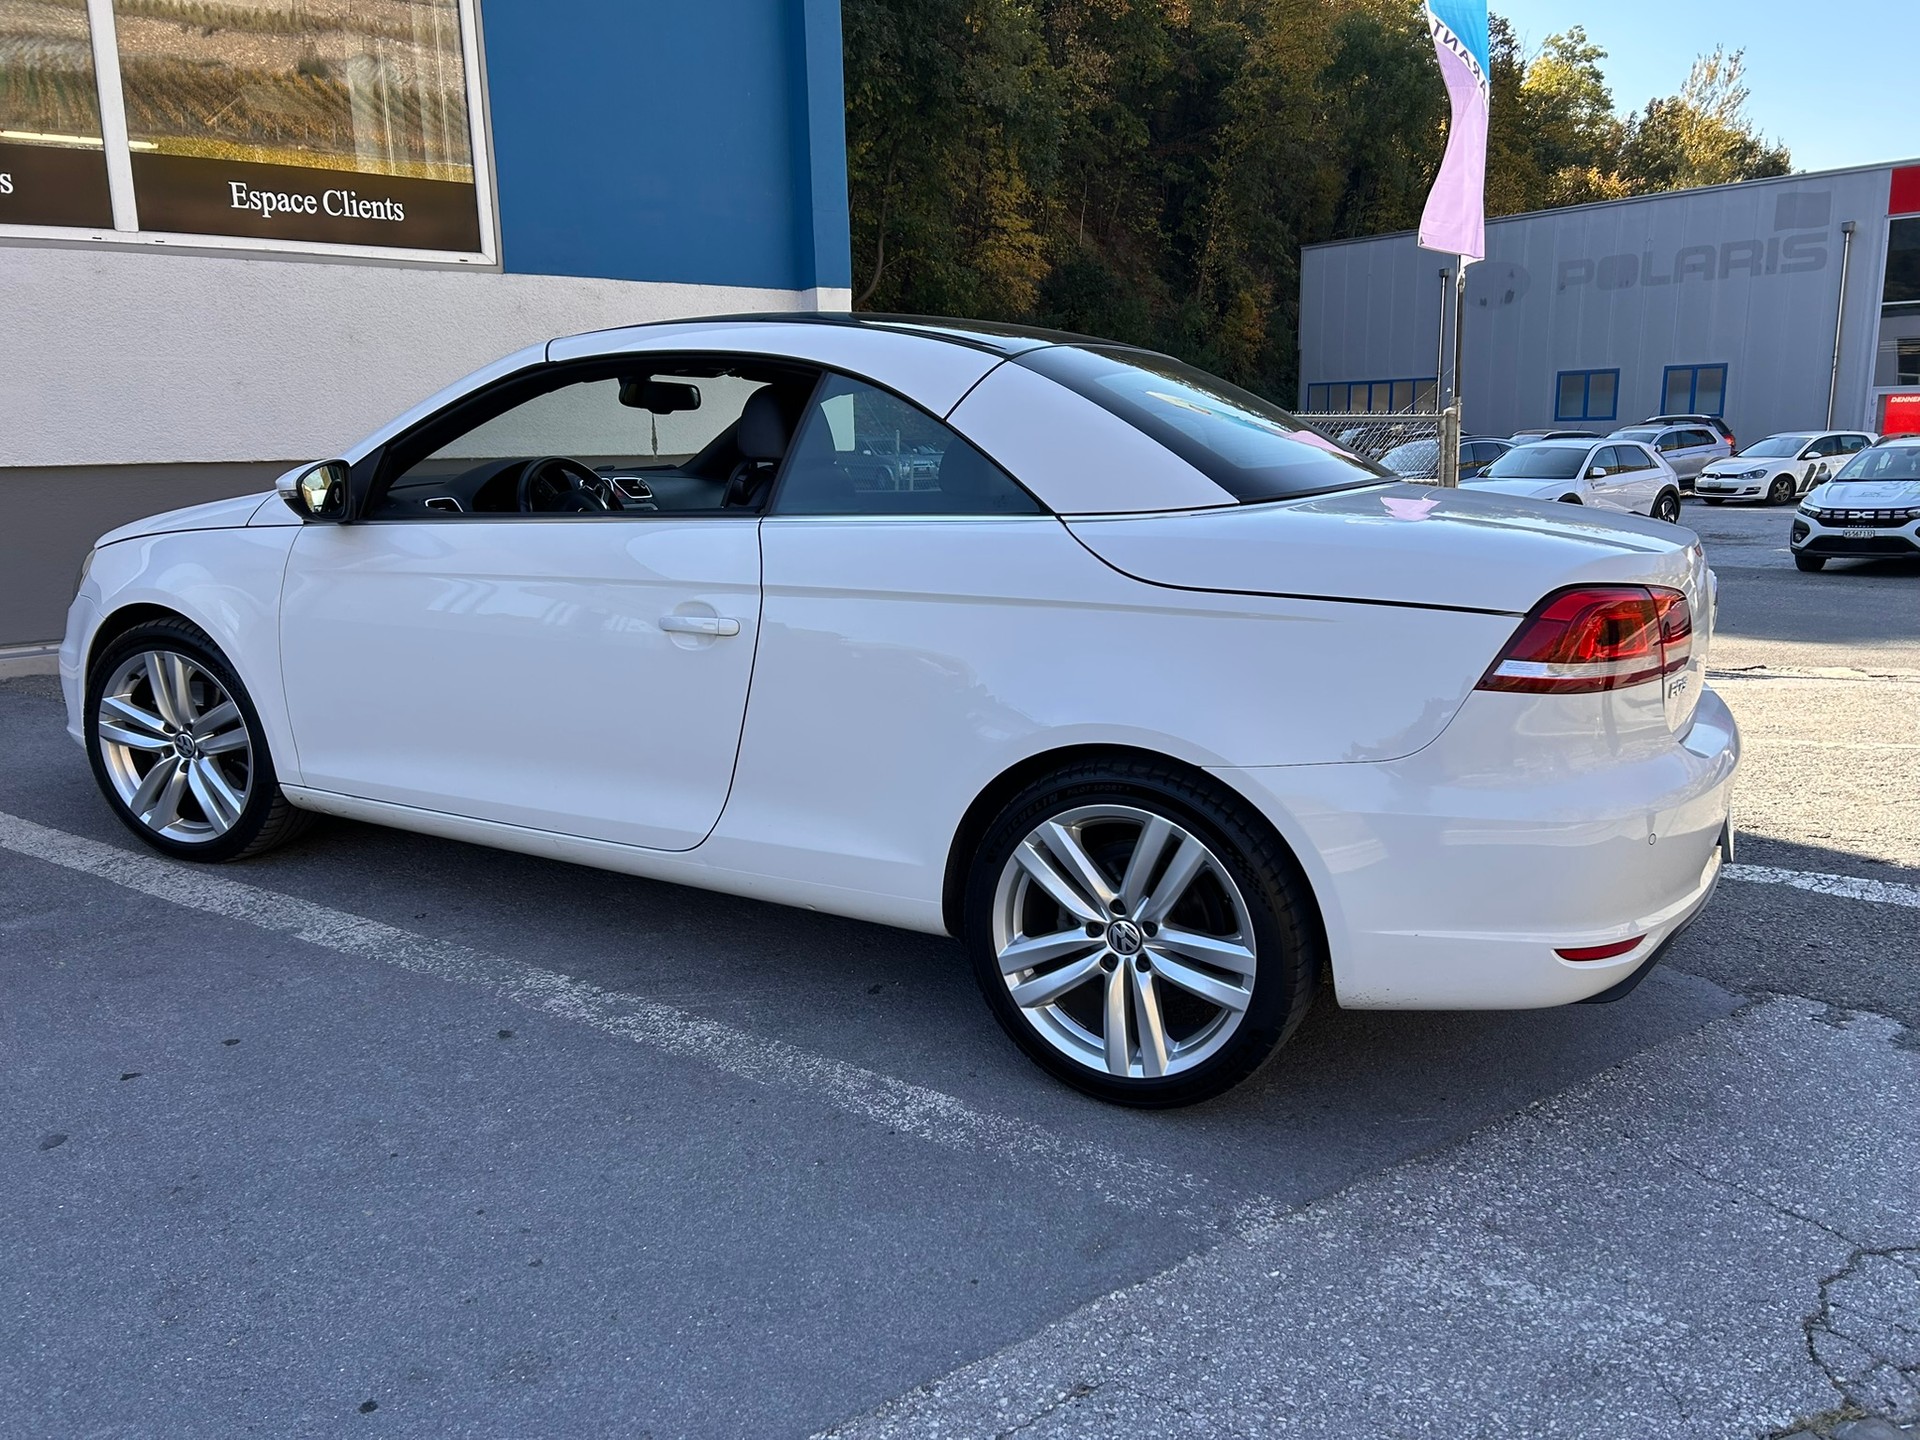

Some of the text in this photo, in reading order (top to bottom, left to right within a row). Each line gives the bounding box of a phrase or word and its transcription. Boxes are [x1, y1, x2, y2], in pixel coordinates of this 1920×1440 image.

[228, 181, 405, 222] Espace Clients
[1556, 232, 1829, 295] POLARIS
